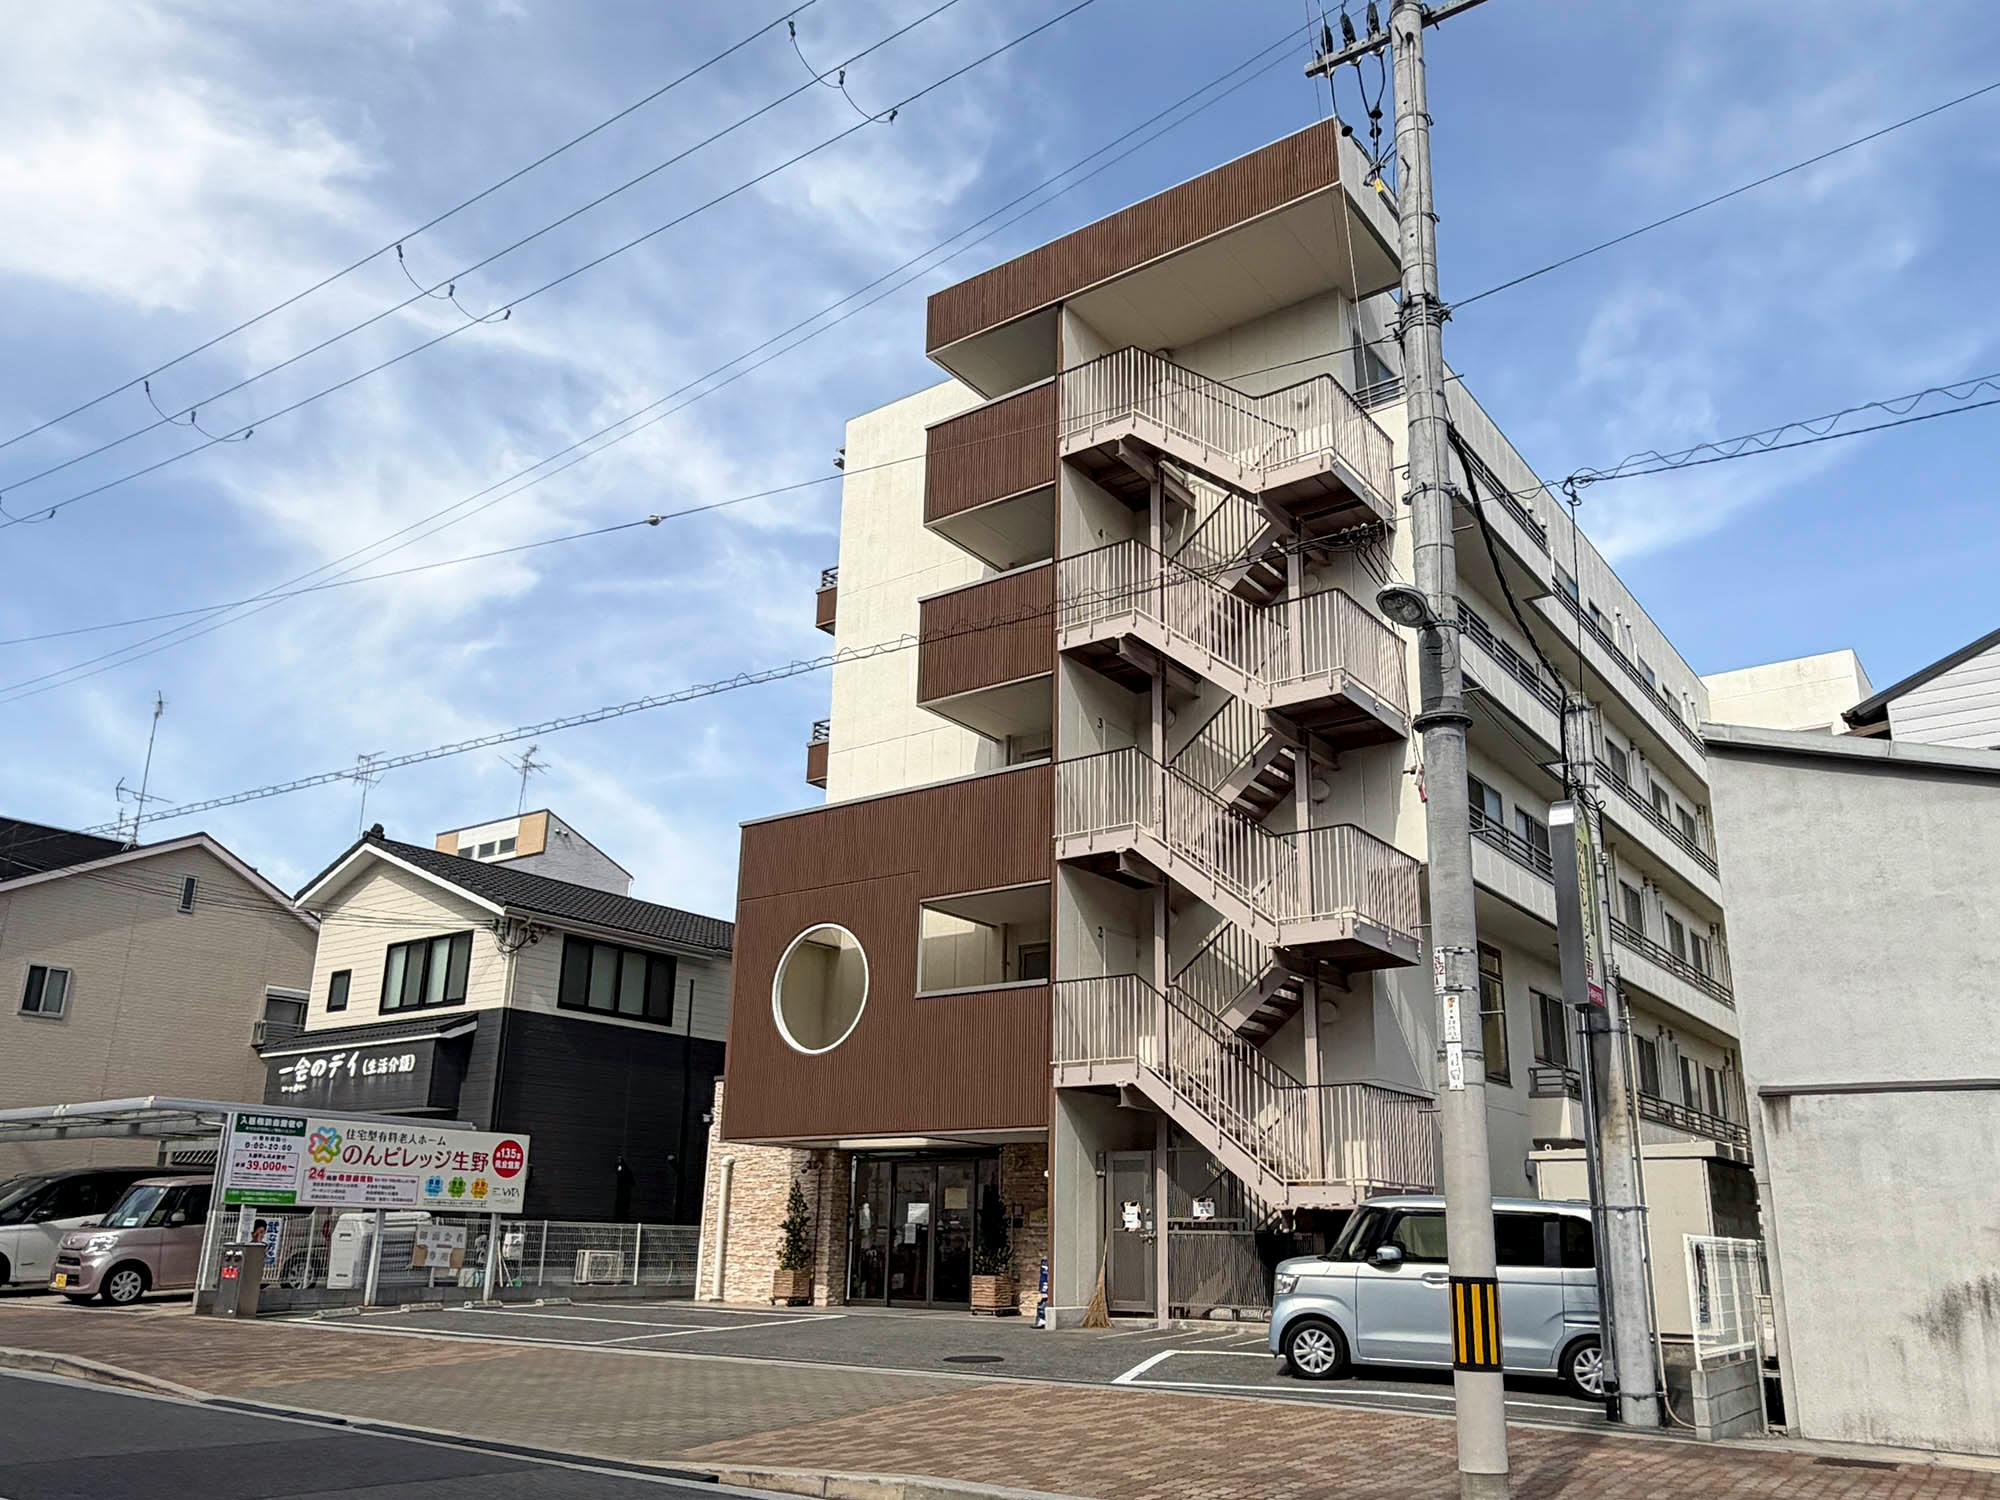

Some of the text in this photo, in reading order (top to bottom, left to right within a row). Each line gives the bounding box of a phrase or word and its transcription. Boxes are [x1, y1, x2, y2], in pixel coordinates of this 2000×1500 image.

[346, 1128, 446, 1146] 住宅型有料老人ホーム
[342, 1144, 489, 1173] のんビレッジ生野
